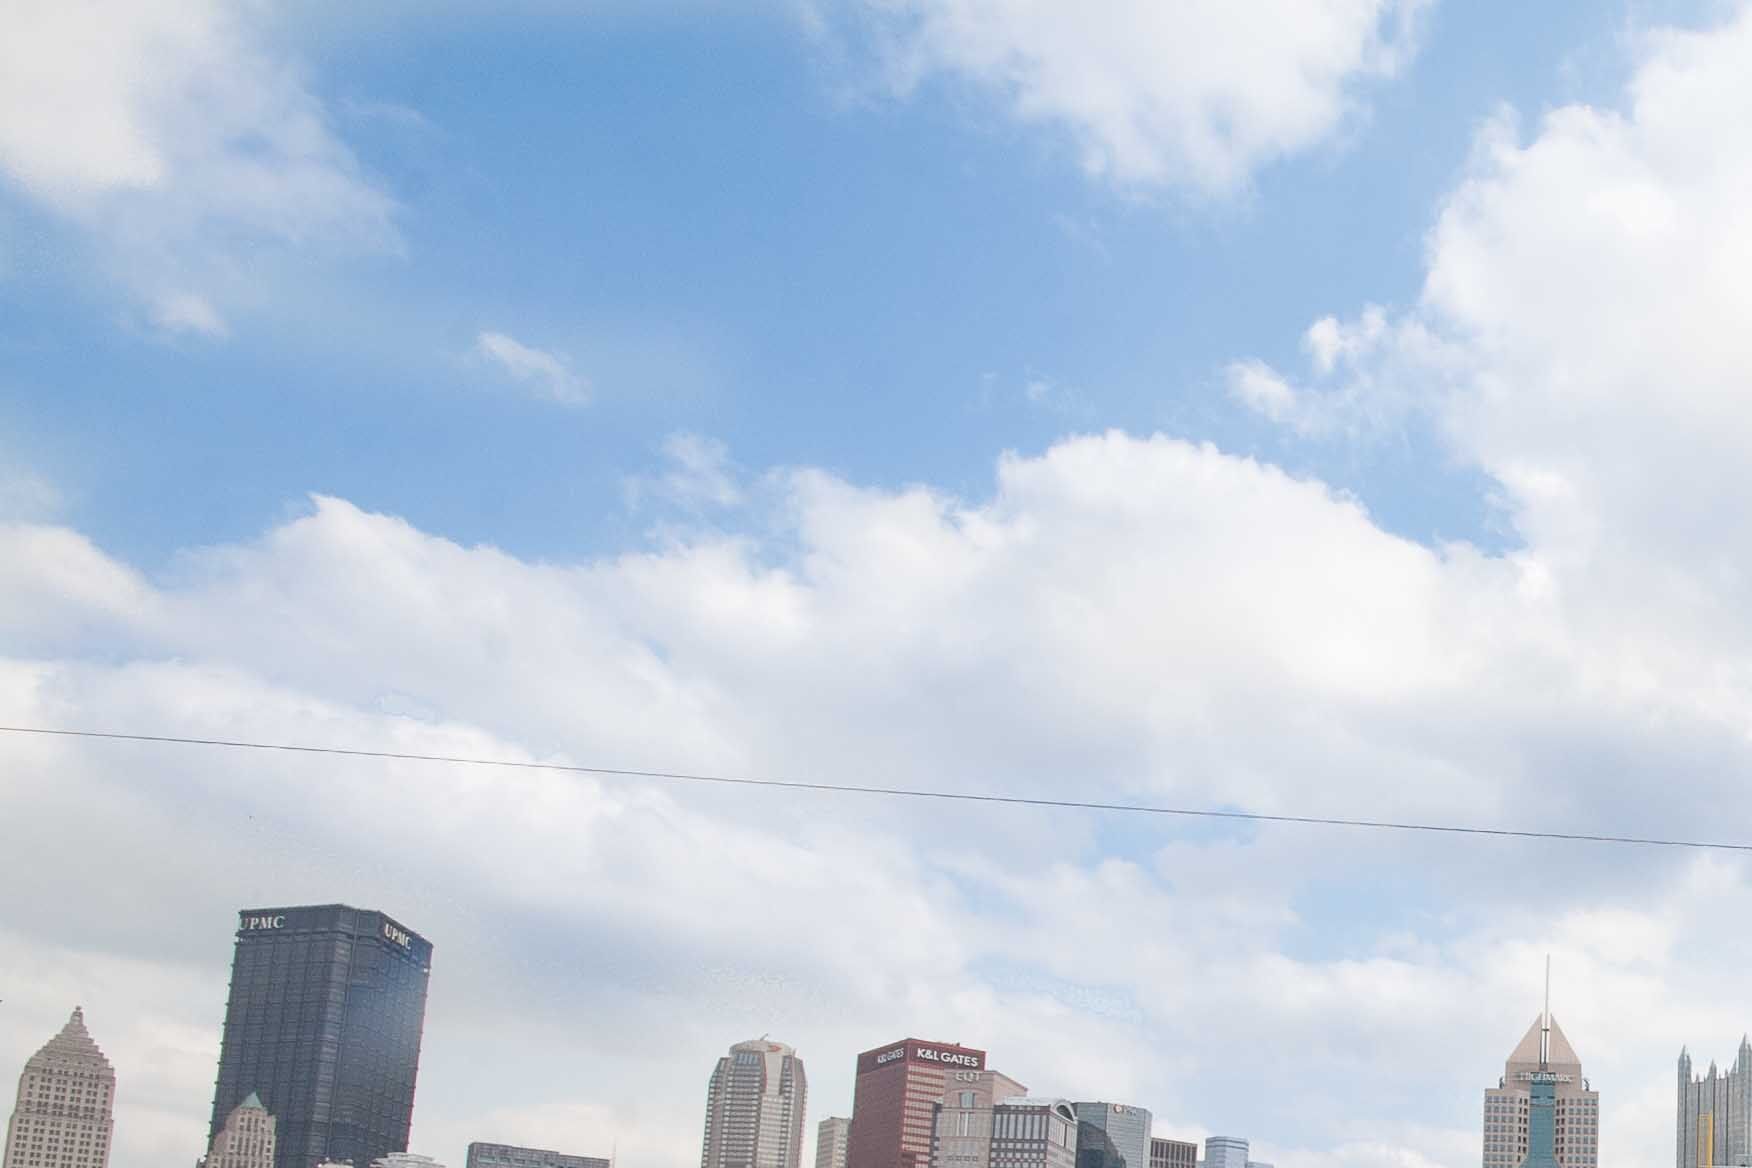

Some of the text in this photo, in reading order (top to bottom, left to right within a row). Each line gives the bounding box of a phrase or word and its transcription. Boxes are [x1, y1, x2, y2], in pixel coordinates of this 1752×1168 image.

[239, 915, 285, 930] UPMC
[384, 923, 412, 950] UPMC
[917, 1048, 979, 1067] K&L GATES
[955, 1072, 980, 1081] EQT
